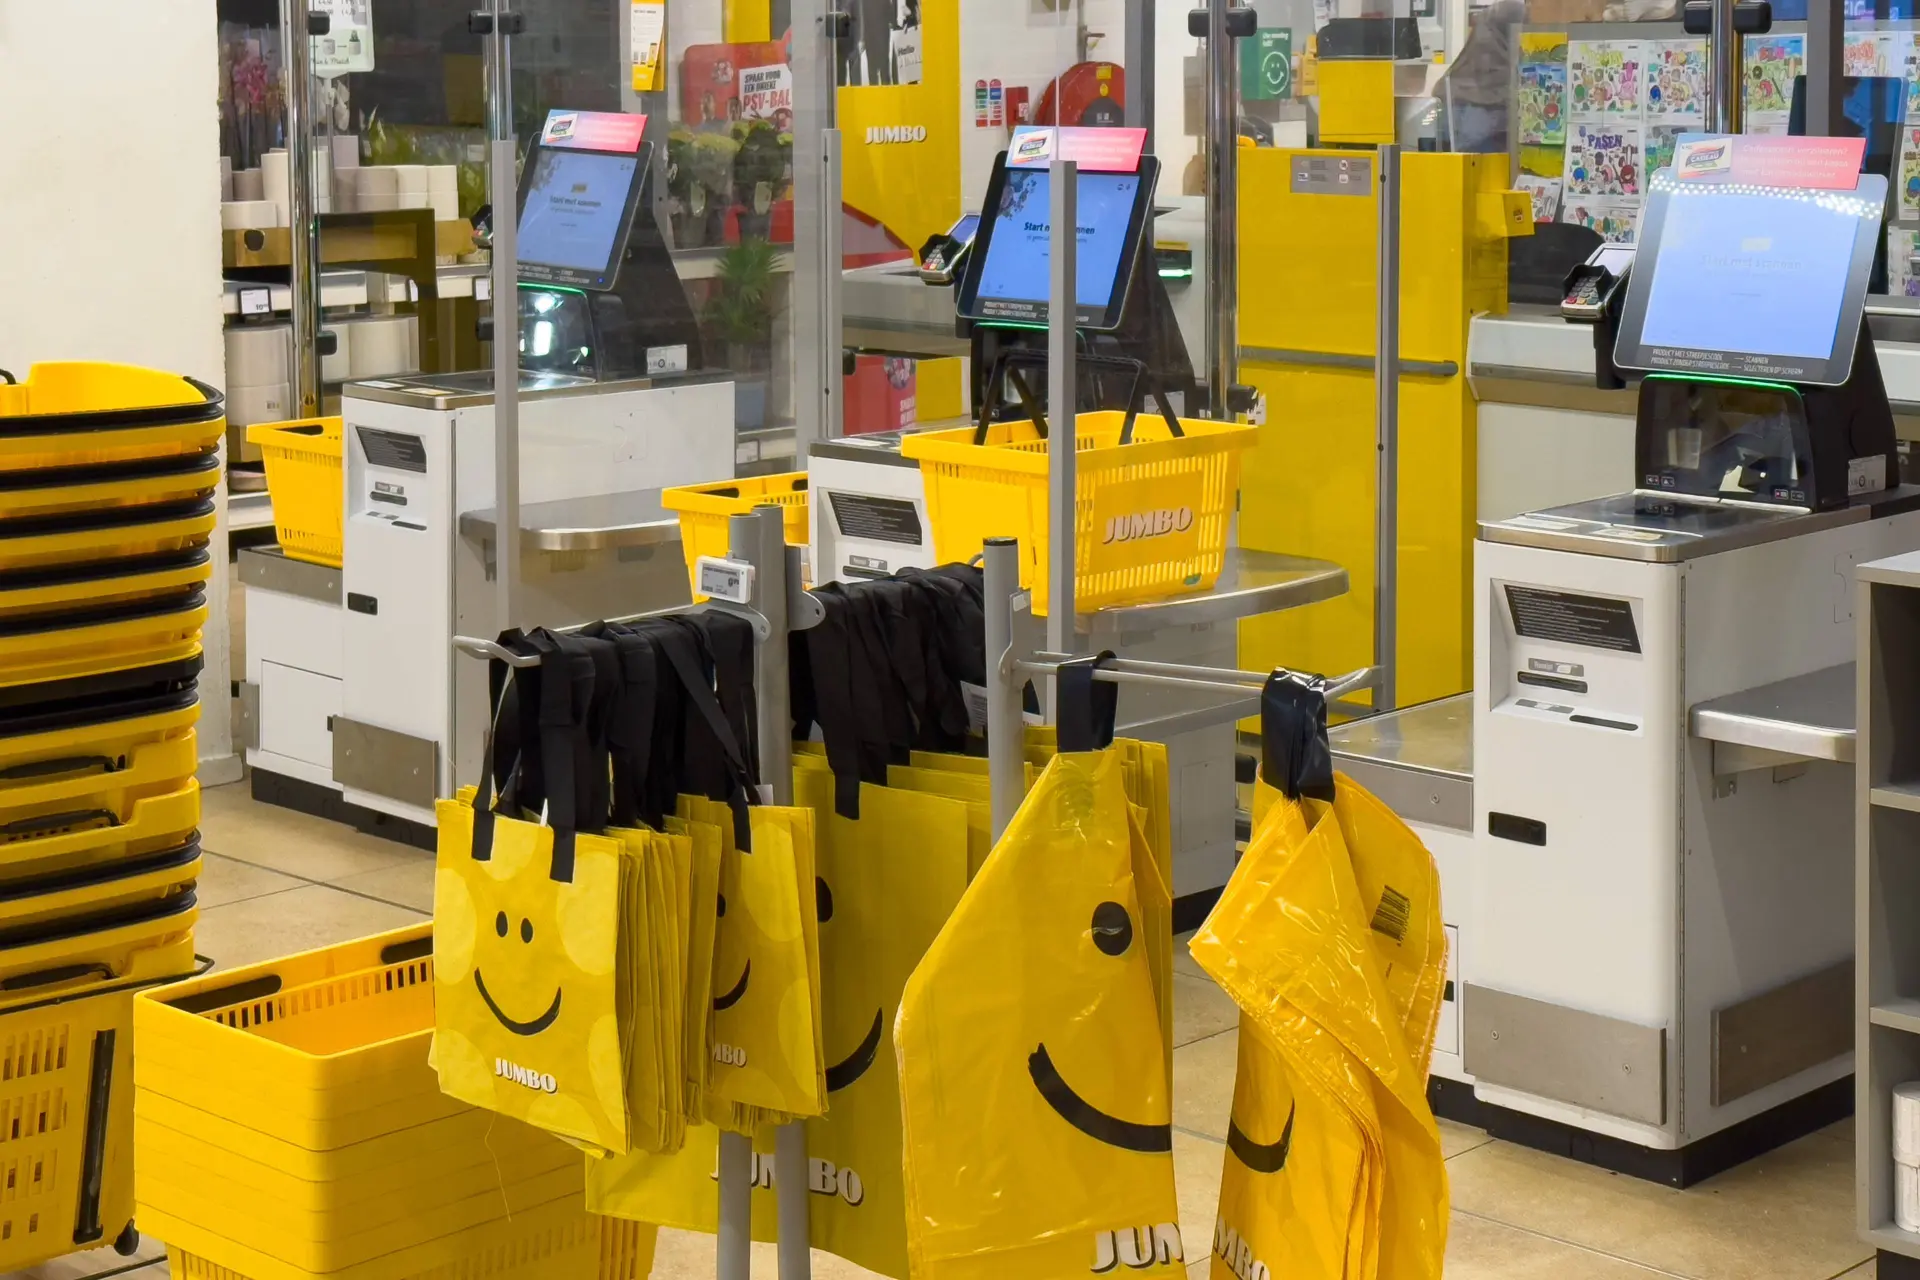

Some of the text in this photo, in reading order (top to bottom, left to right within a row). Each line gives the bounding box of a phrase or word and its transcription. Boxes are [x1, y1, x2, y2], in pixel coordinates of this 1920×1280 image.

[864, 125, 927, 145] JUMBO
[1587, 134, 1623, 150] PASEN
[1102, 507, 1193, 545] JUMBO
[495, 1057, 558, 1095] JUMBO
